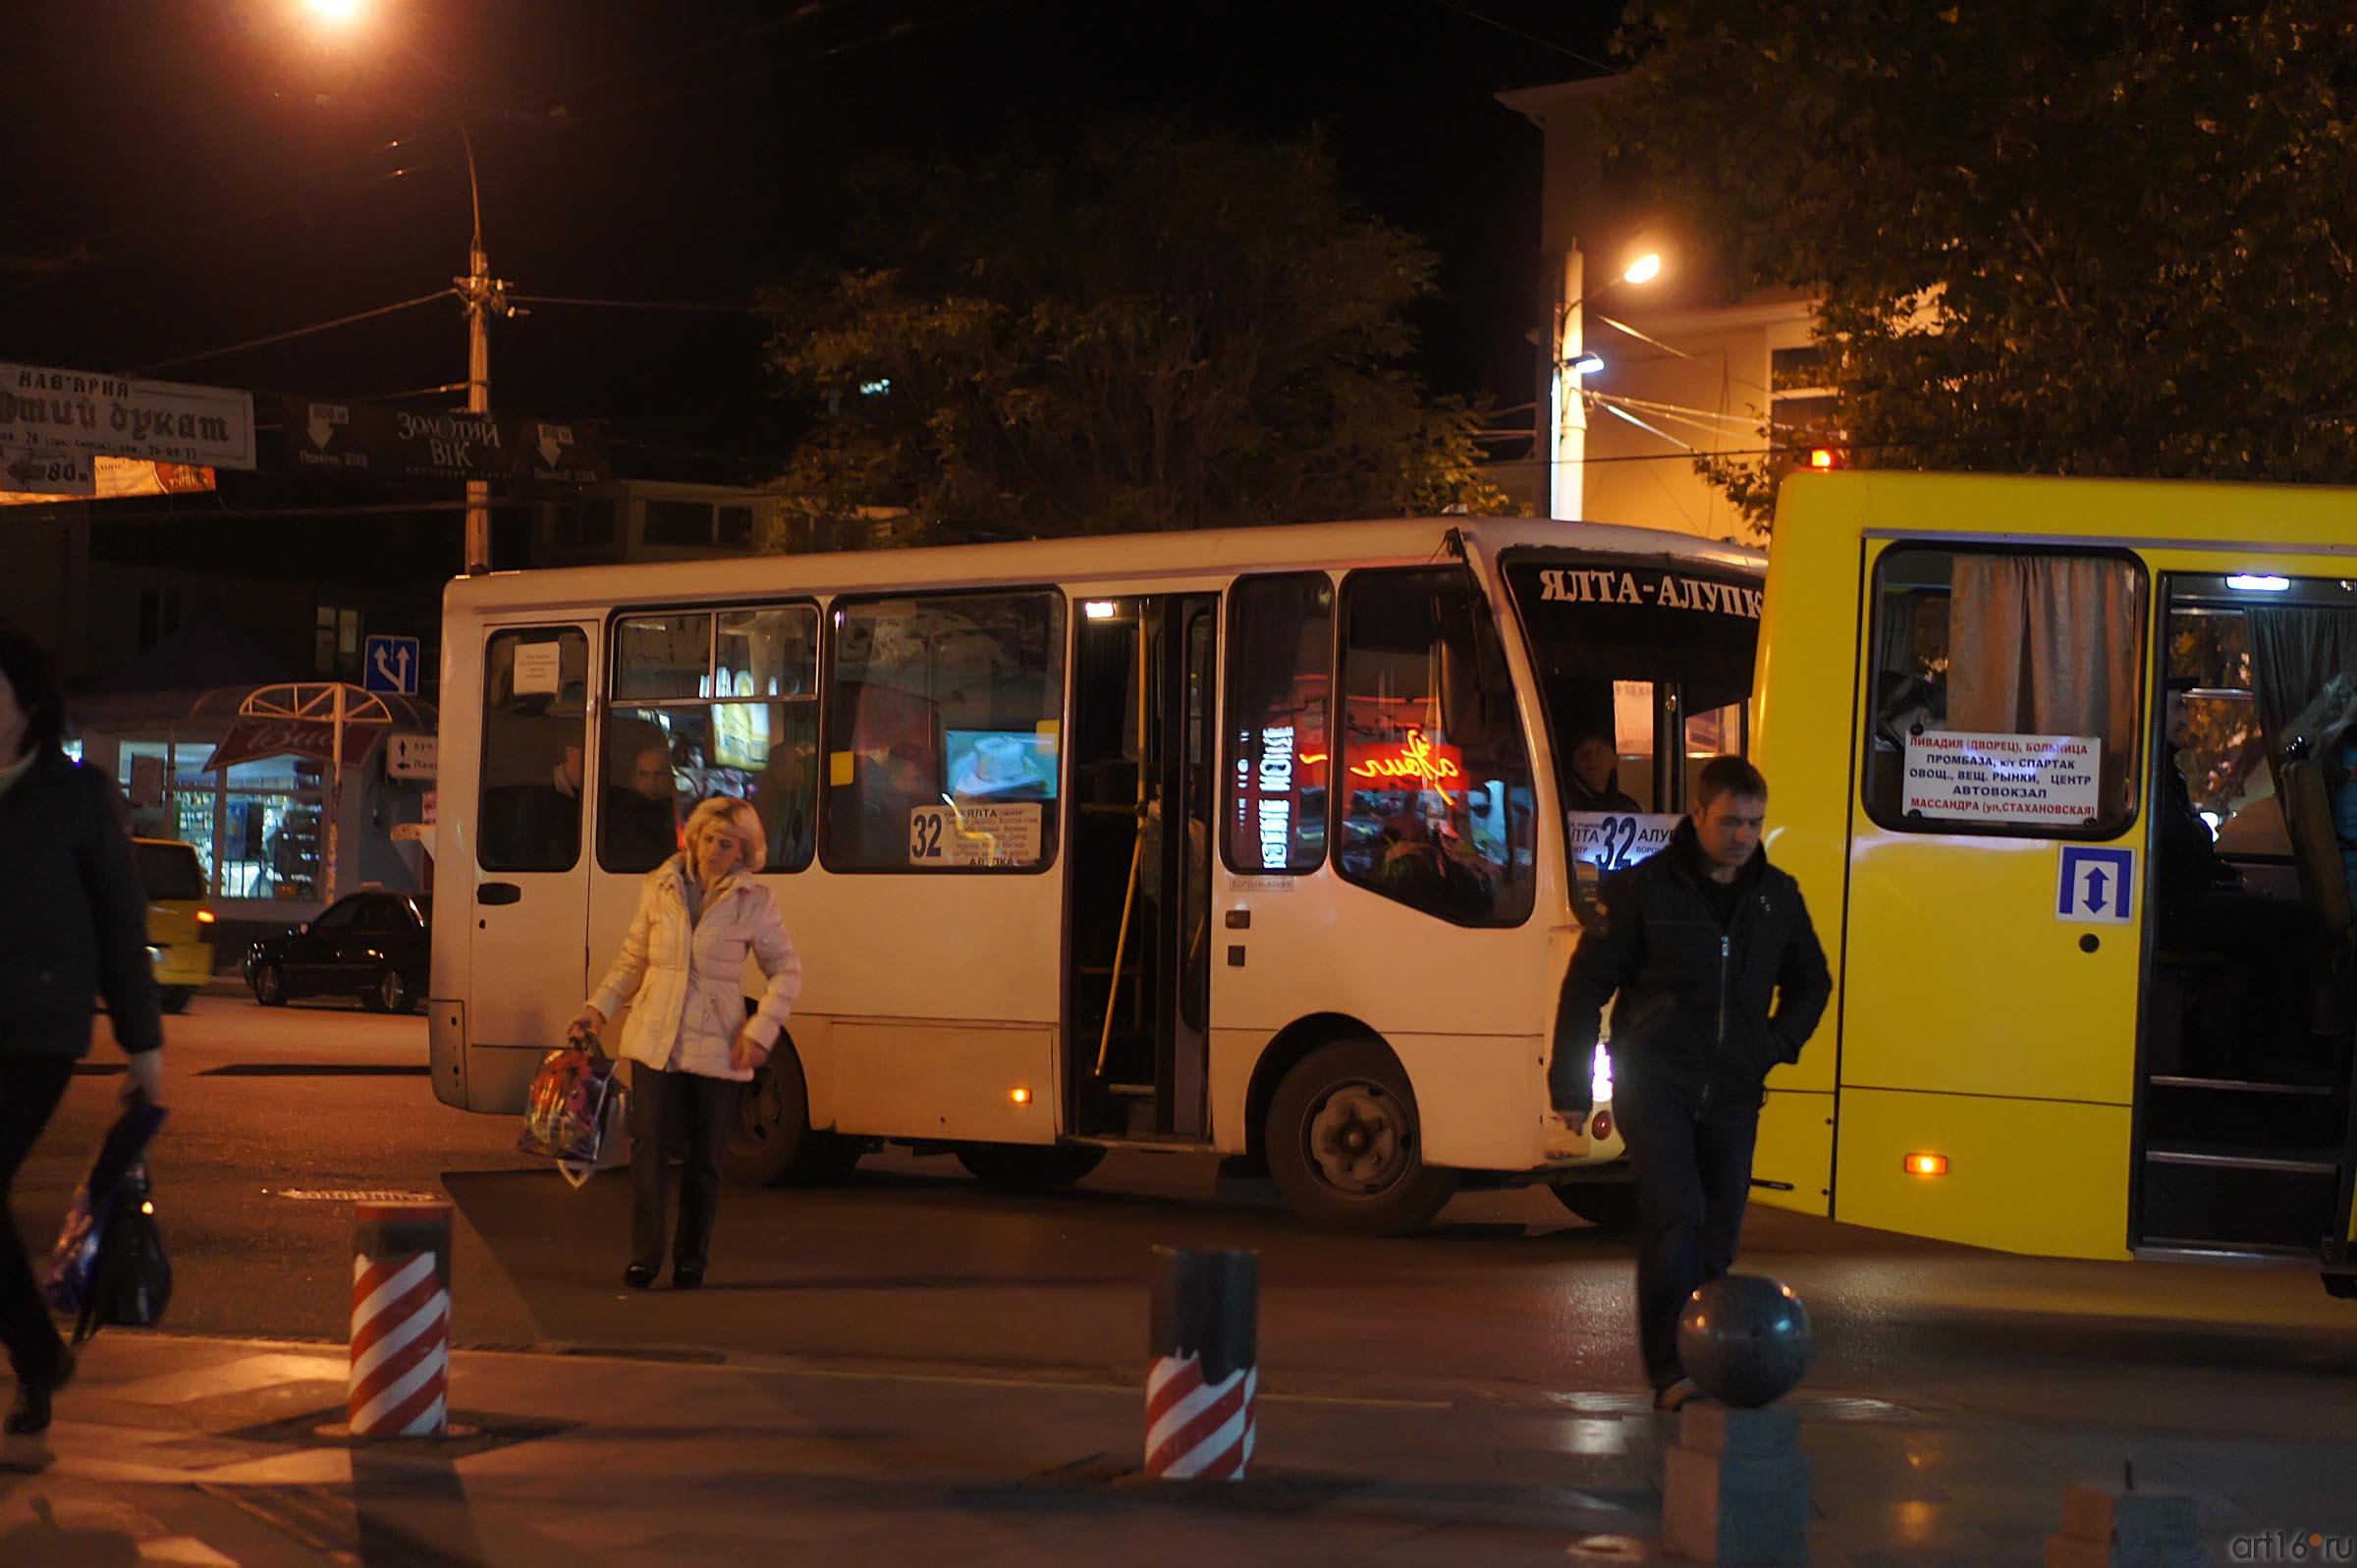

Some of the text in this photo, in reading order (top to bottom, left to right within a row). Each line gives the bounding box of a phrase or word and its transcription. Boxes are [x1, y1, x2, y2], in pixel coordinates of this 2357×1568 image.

[0, 392, 230, 441] отий дукат
[397, 412, 500, 449] ЗОЛОТИЙ
[429, 438, 473, 469] ВІК
[47, 463, 76, 481] 80
[1910, 737, 1963, 750] ЛИВАДИЯ
[2026, 743, 2088, 756] БОЛЬНИЦА
[1926, 754, 1997, 768] ПРОМБАЗА,
[2019, 759, 2075, 770] СПАРТАК
[1957, 771, 1988, 783] ВЕЩ.
[1993, 773, 2040, 784] РЫНКИ,
[2051, 776, 2092, 786] ЦЕНТР
[1952, 785, 2048, 799] АВТОВОКЗАЛ
[1910, 798, 1979, 811] МАССАНДРА
[966, 809, 997, 818] ЯЛТА
[911, 813, 943, 859] 32
[1570, 829, 1599, 843] ЛТА
[1595, 816, 1637, 871] 32
[968, 856, 1014, 867] АЛПКА
